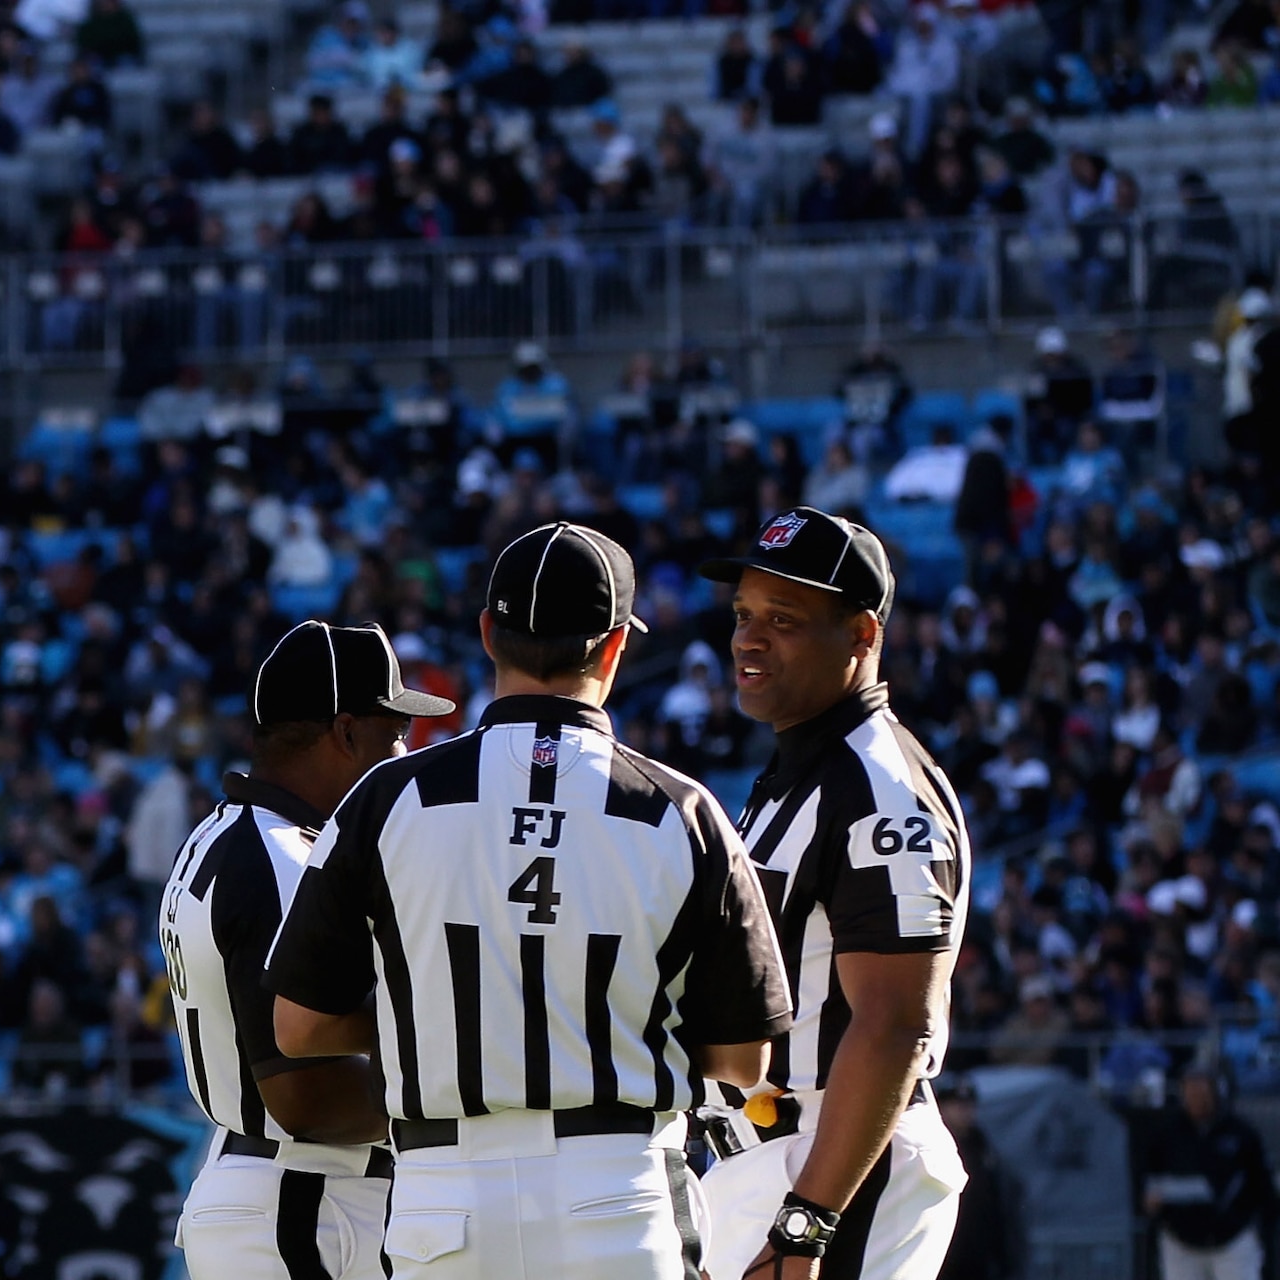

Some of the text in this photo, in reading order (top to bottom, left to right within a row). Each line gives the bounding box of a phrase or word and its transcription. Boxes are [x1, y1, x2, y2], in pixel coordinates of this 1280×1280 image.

[762, 526, 796, 545] NFL
[497, 599, 509, 614] BL
[532, 750, 557, 763] NFL
[509, 807, 567, 849] FJ
[872, 816, 933, 856] 62
[507, 856, 562, 925] 4
